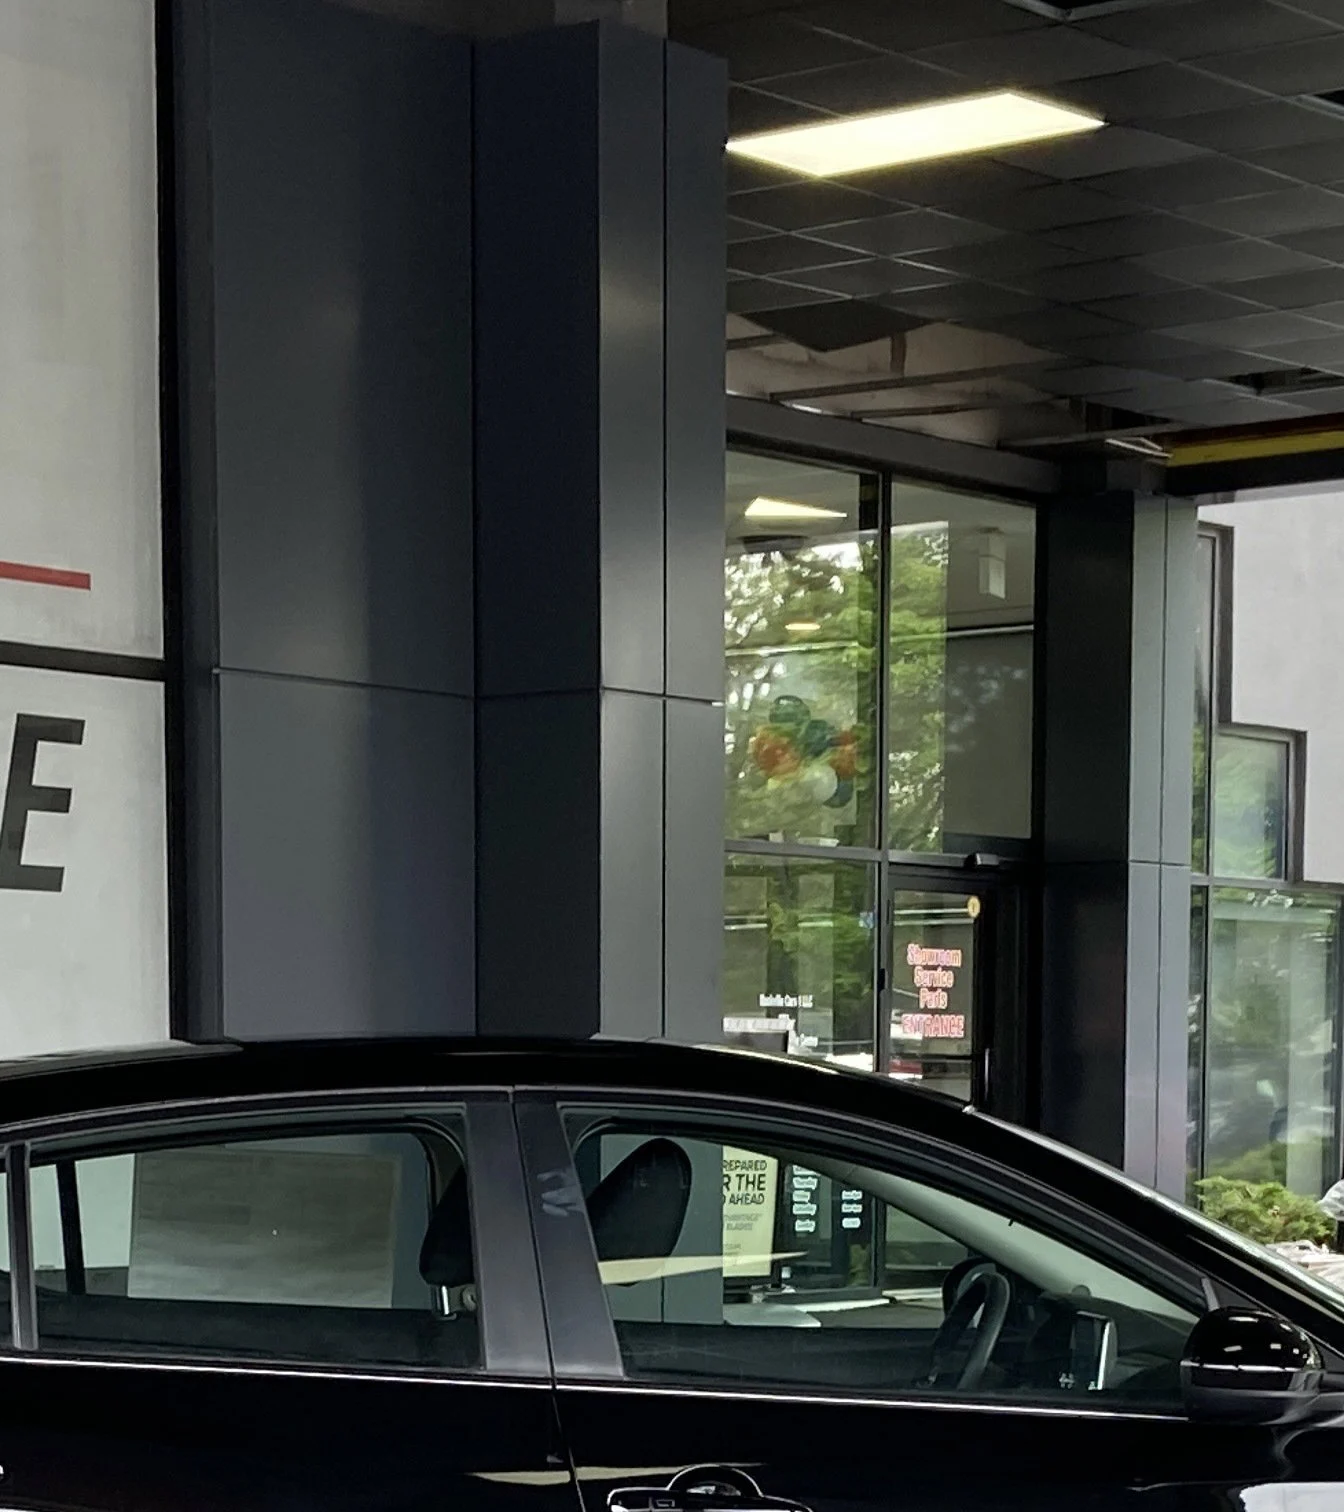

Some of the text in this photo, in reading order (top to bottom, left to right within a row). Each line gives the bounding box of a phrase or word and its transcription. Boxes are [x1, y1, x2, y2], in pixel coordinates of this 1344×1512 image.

[914, 966, 954, 988] Service
[919, 988, 948, 1009] Parts
[902, 1013, 965, 1038] ENTRANCE
[736, 1174, 766, 1192] THE
[729, 1193, 765, 1205] AHEAD
